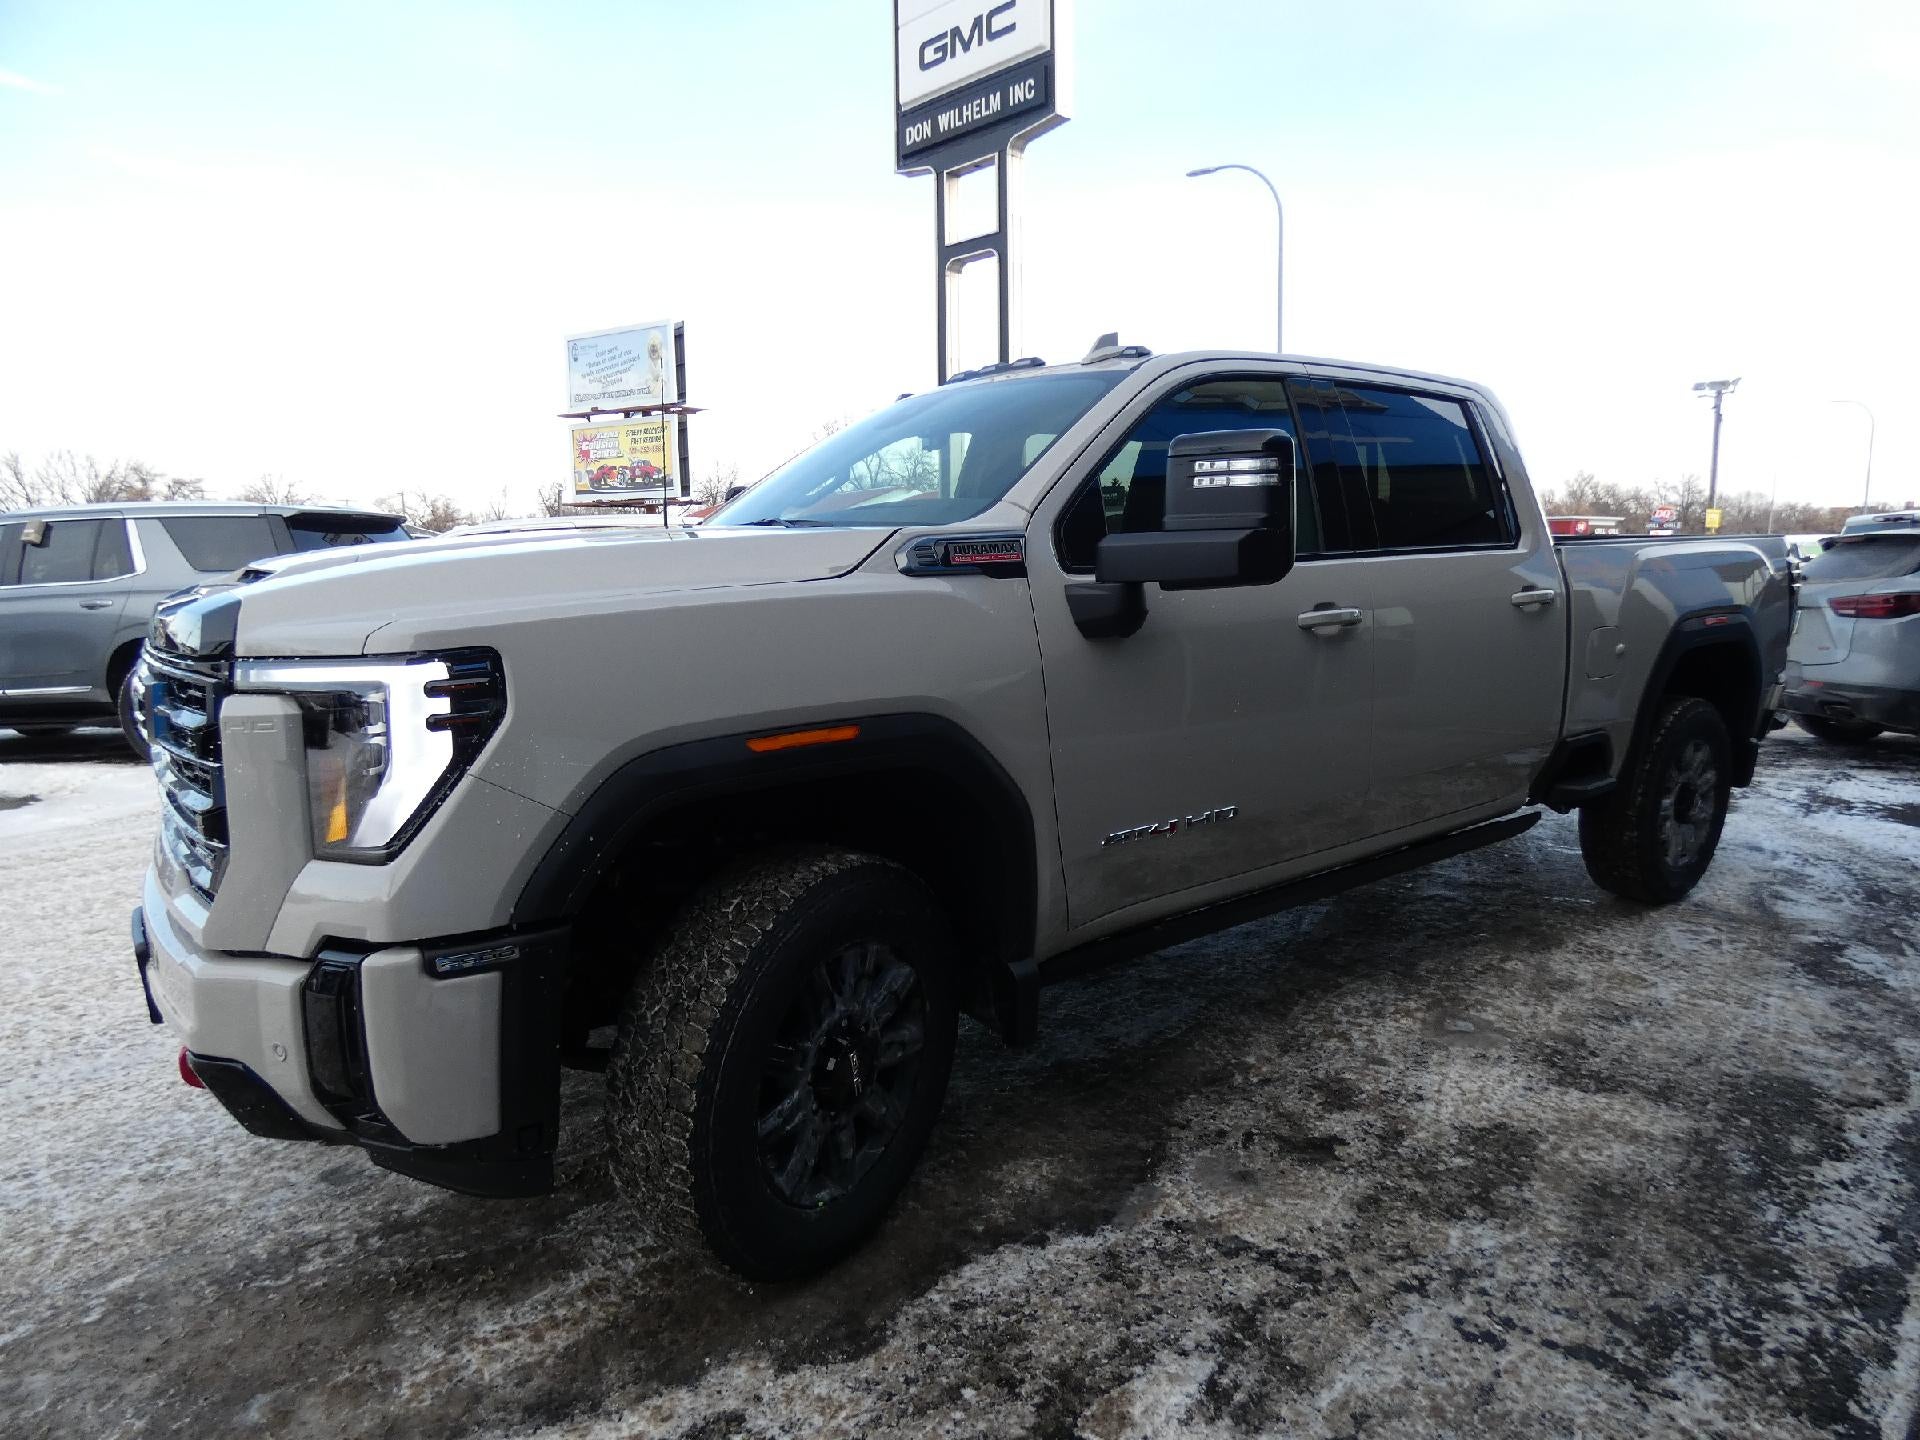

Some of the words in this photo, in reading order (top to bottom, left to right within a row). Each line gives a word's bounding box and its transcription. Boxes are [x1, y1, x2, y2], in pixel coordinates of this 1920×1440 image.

[919, 0, 1016, 71] GMC
[905, 120, 931, 146] DON
[938, 91, 1000, 132] WILHELM
[1009, 78, 1035, 107] INC
[953, 543, 1017, 554] DURAMAX
